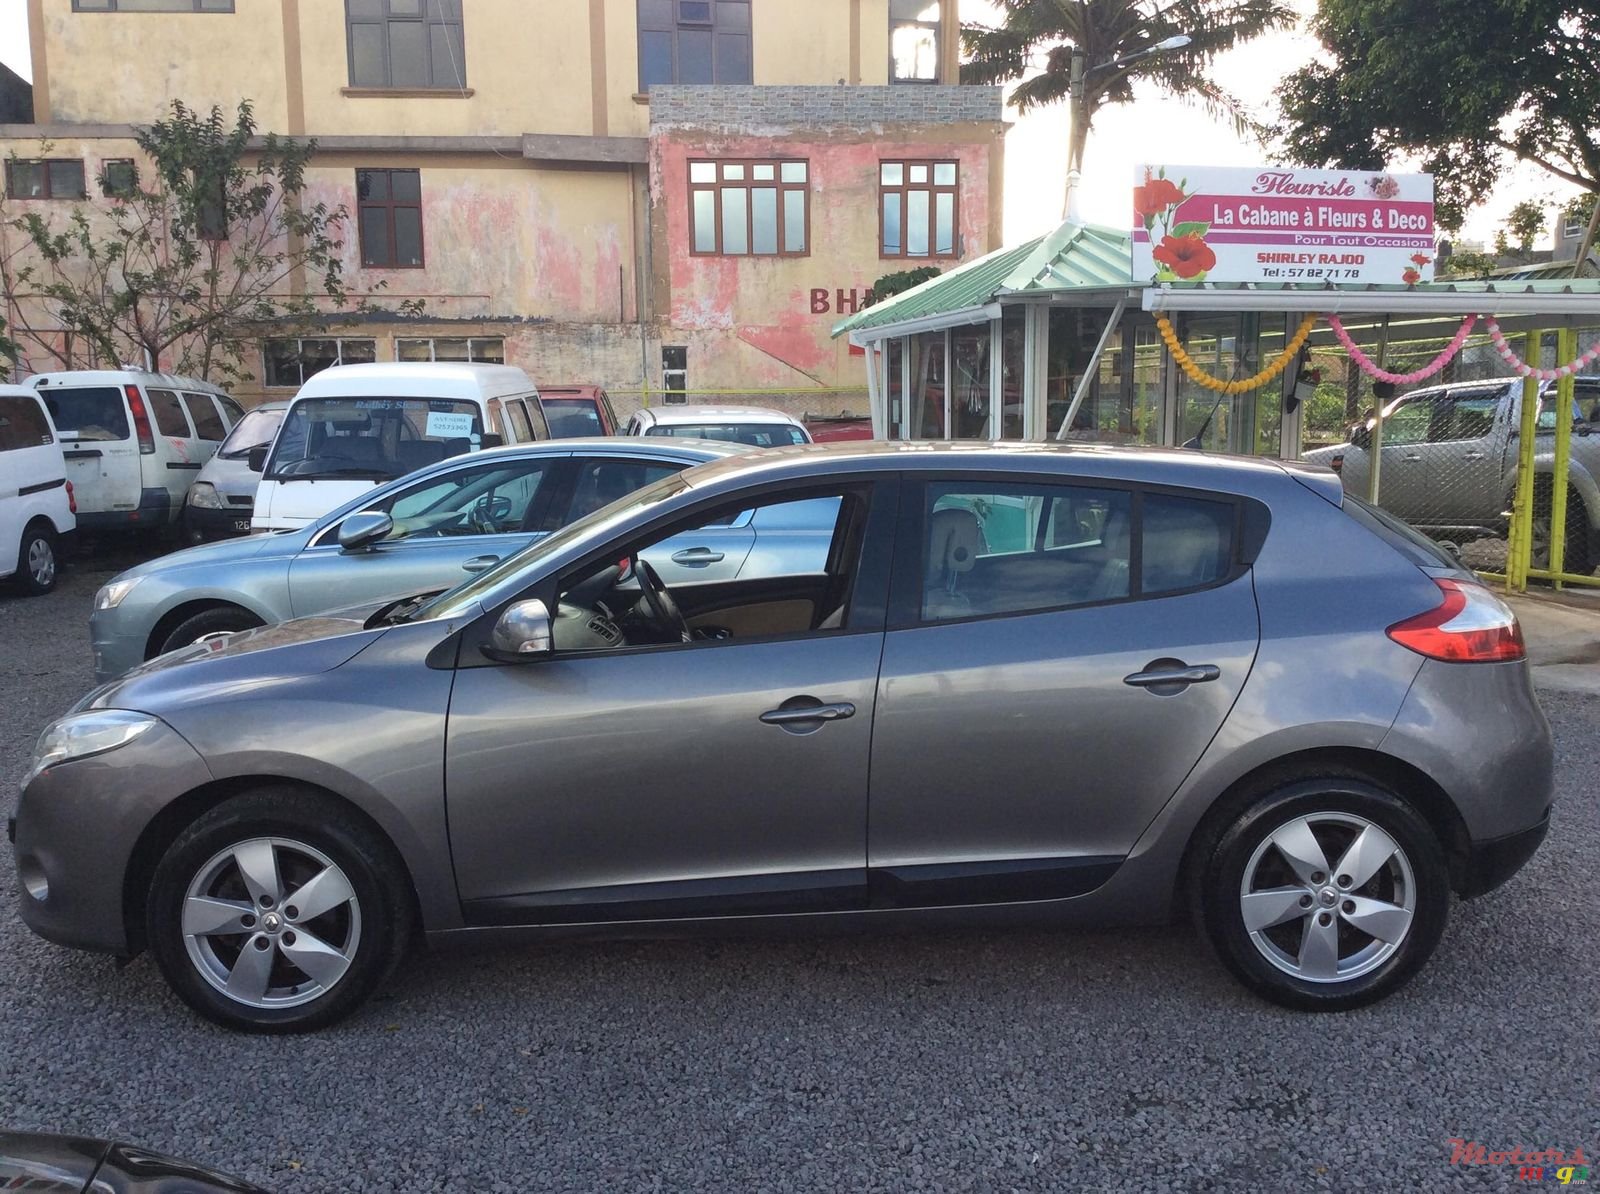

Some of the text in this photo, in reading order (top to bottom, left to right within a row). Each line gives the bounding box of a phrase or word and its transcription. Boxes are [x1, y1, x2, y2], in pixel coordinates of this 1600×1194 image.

[1251, 172, 1356, 196] Fleuriste
[1213, 203, 1427, 230] La Cabane à Fleurs & Deco
[1294, 234, 1428, 248] Pour Tout Occasion
[1257, 252, 1365, 265] SHIRLEY RAJOO
[1288, 268, 1304, 278] 57
[1306, 268, 1323, 278] 82
[1326, 269, 1340, 278] 71
[1344, 269, 1360, 279] 78
